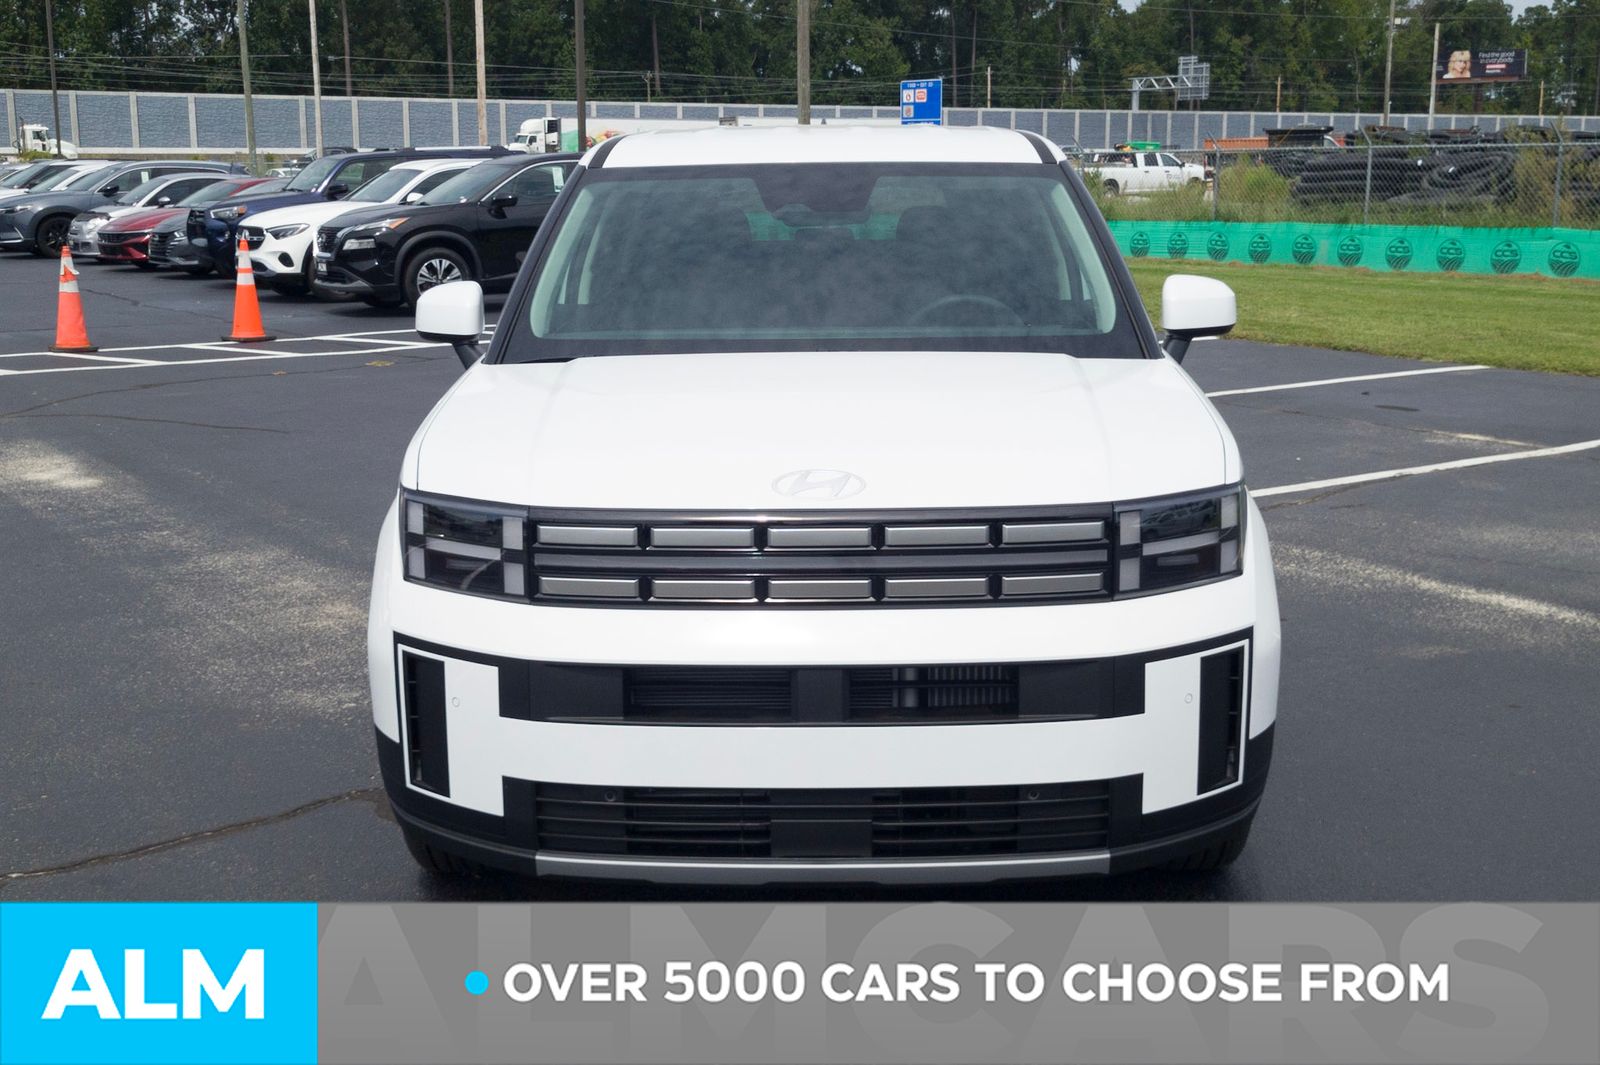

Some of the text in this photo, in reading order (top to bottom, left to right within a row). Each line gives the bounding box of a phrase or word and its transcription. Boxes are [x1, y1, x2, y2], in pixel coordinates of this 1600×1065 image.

[1251, 240, 1270, 249] CCS
[1294, 241, 1314, 250] CCS
[1340, 243, 1361, 252] CCS
[1389, 245, 1411, 254] CCS
[1440, 247, 1463, 256] CCS
[1494, 249, 1519, 258] CCS
[1552, 250, 1578, 261] CCS
